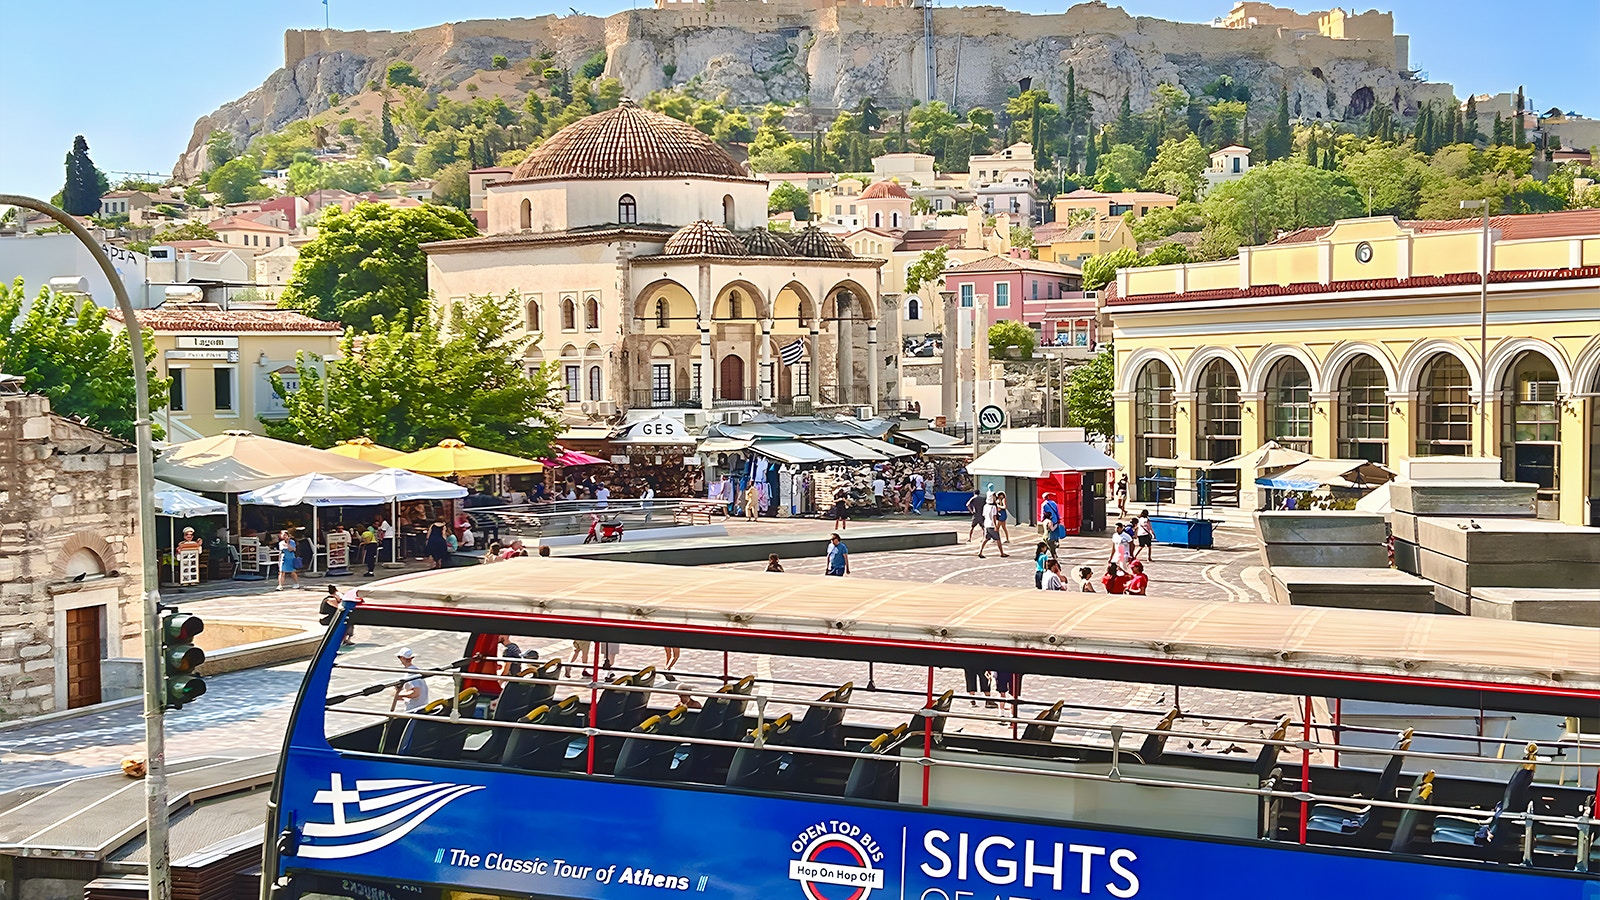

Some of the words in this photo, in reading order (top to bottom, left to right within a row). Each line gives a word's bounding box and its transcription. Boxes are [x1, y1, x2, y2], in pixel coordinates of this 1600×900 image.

[643, 423, 674, 435] GES
[791, 821, 828, 853] OPEN
[829, 820, 861, 837] TOP
[860, 833, 884, 863] BUS
[450, 848, 480, 868] The
[485, 852, 548, 876] Classic
[553, 859, 592, 880] Tour
[596, 864, 617, 885] of
[618, 867, 690, 890] Athens
[797, 866, 817, 878] Hop
[820, 867, 834, 878] On
[837, 870, 857, 882] Hop
[860, 872, 876, 882] Off
[920, 829, 1140, 898] SIGHTS
